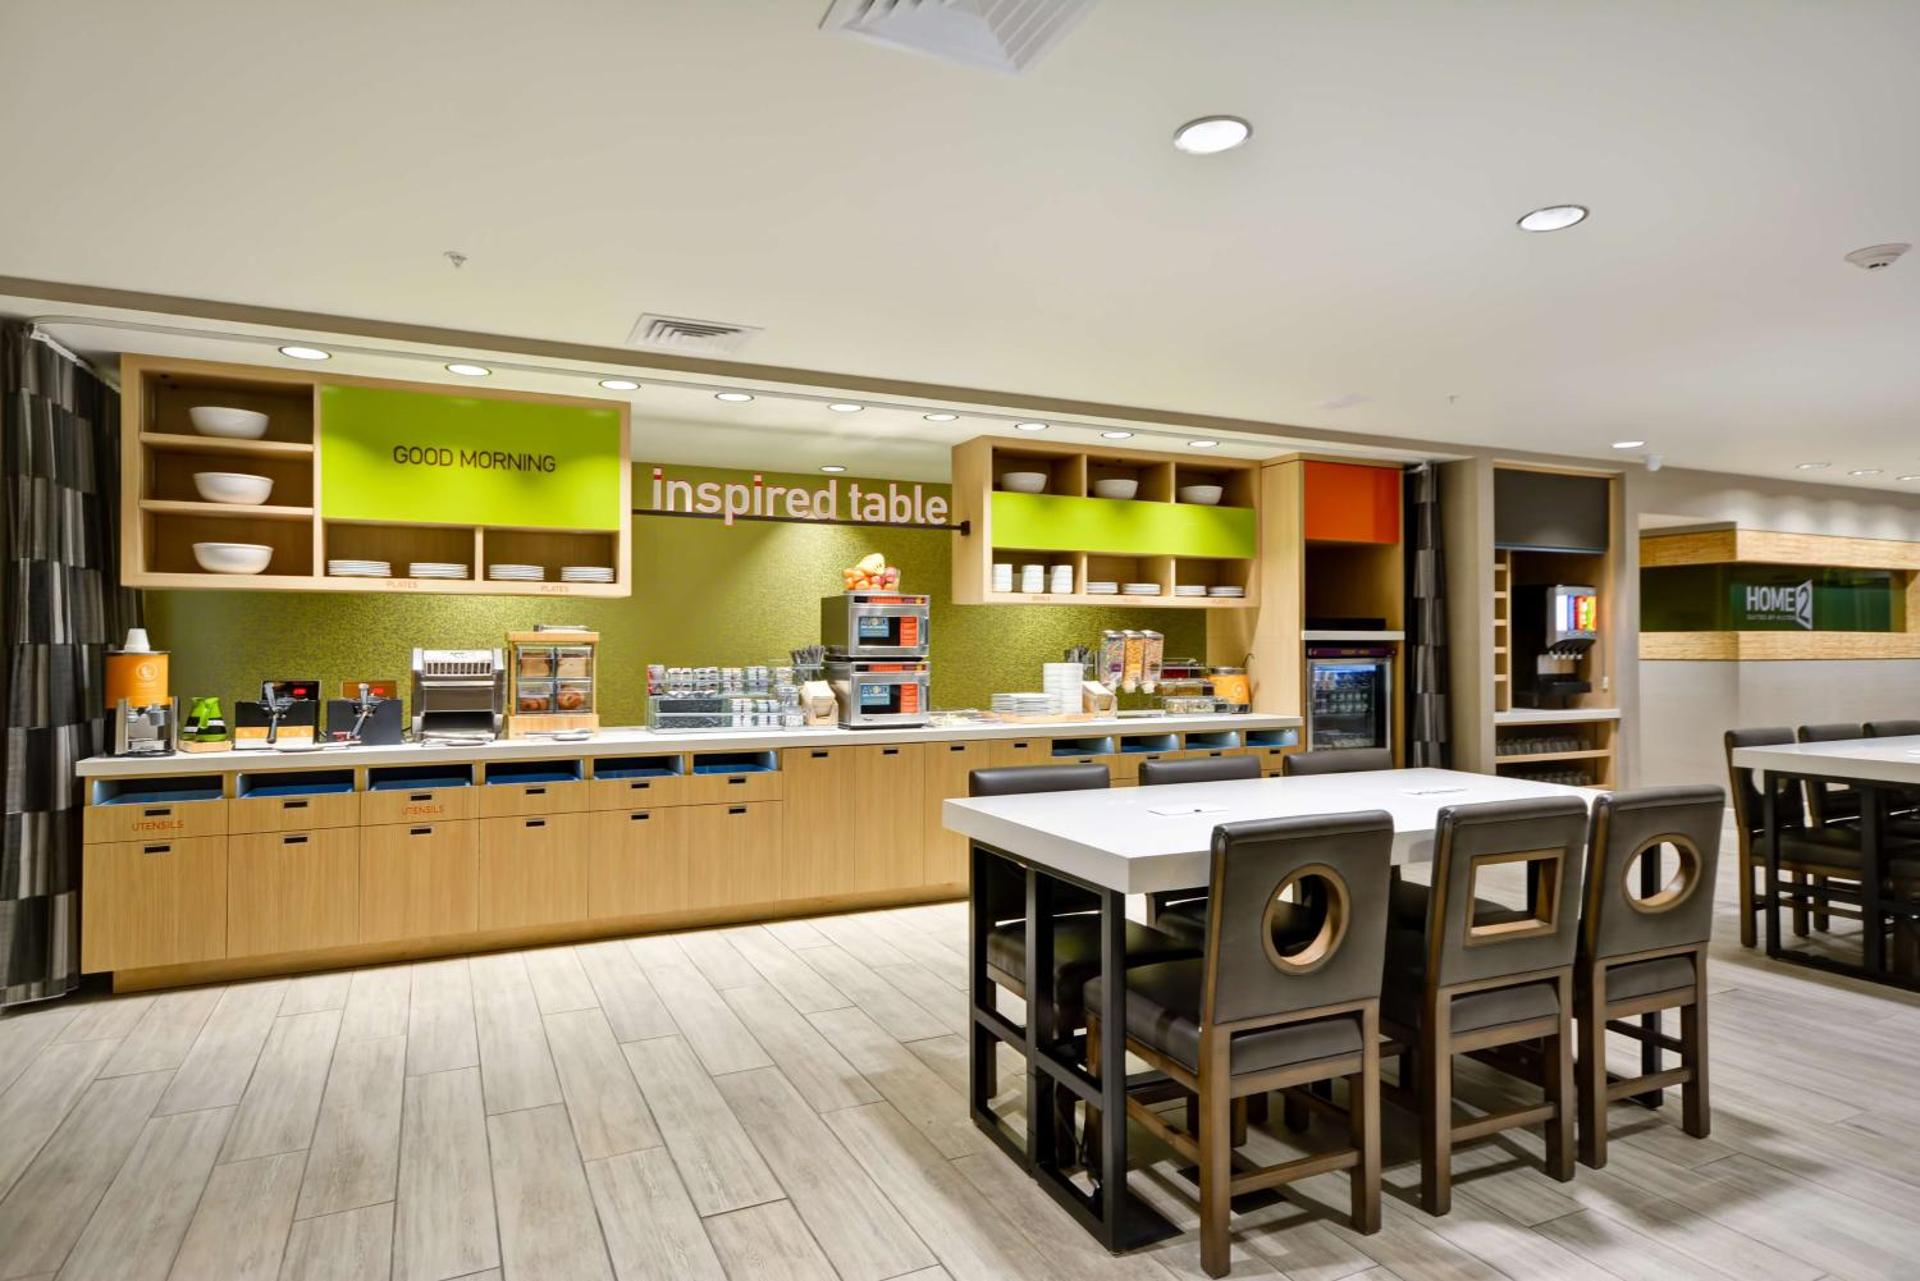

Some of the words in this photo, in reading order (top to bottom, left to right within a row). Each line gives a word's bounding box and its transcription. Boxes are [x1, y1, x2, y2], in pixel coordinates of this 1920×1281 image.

[393, 445, 453, 467] GOOD
[460, 449, 556, 473] MORNING
[652, 467, 838, 526] inspired
[848, 483, 949, 525] table
[386, 580, 418, 589] PLATES
[401, 804, 445, 816] UTENSILS
[131, 820, 185, 832] UTENSILS
